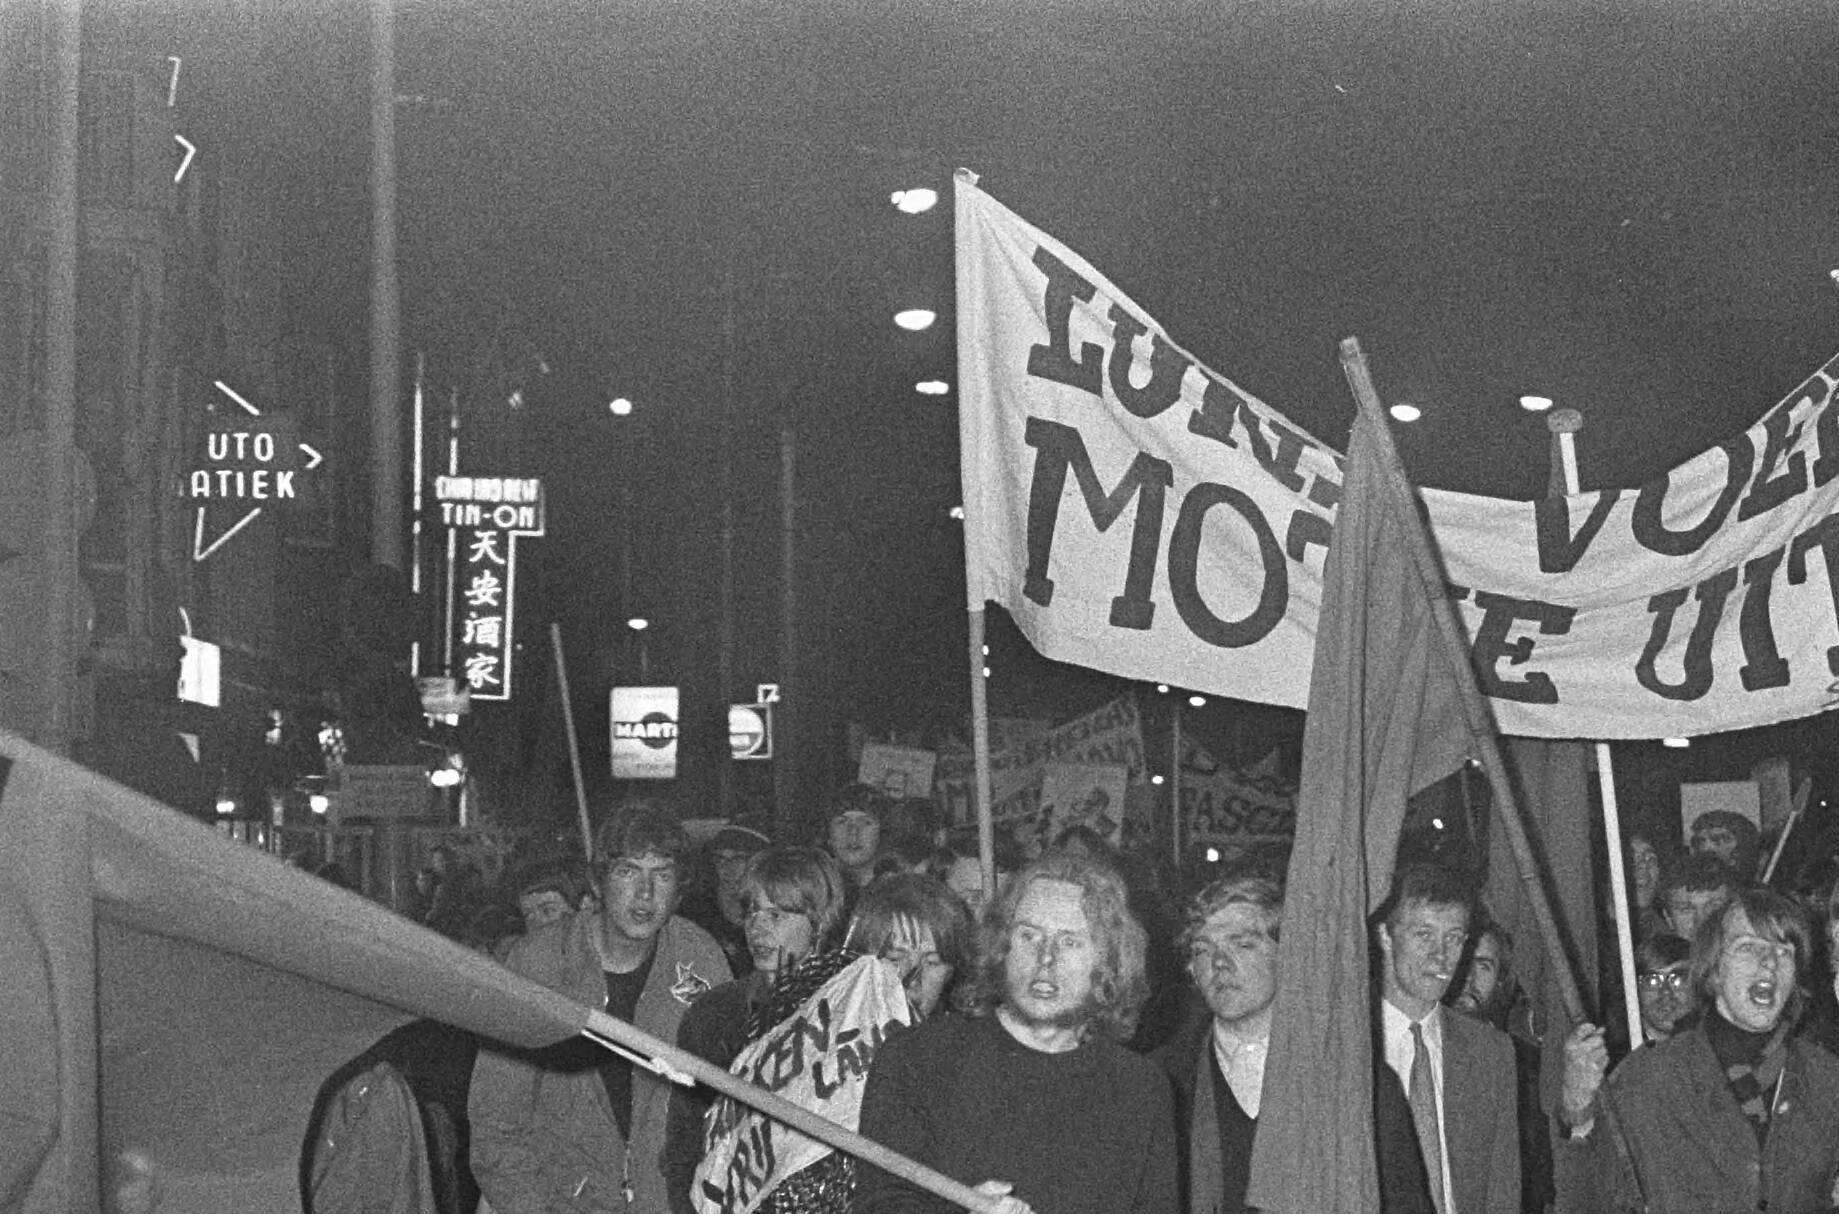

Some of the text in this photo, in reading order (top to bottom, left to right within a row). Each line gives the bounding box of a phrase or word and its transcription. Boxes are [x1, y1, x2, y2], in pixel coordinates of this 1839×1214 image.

[208, 432, 274, 462] UTO
[191, 470, 295, 499] ATIEK
[441, 502, 535, 528] TIN-ON
[462, 530, 506, 689] 天安酒家
